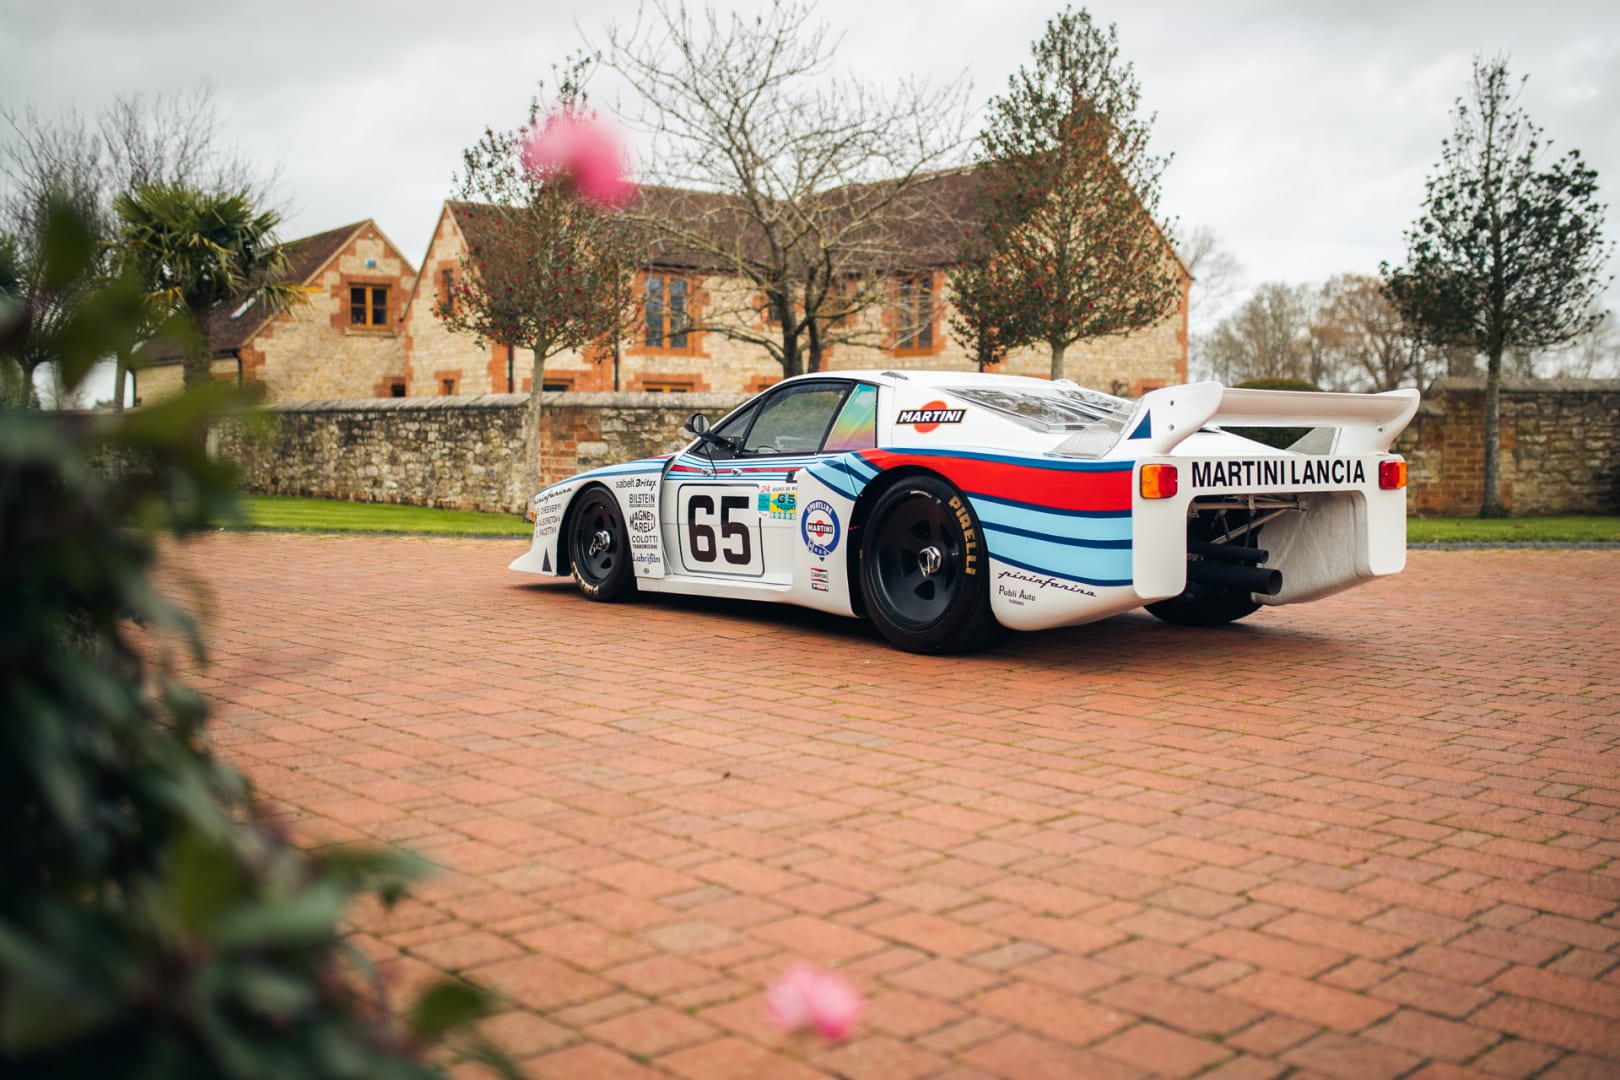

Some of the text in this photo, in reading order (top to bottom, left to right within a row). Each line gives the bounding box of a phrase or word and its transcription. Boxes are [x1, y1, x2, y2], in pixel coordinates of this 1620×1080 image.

[899, 410, 963, 423] MARTINI
[1191, 459, 1366, 488] MARTINI LANCIA
[615, 478, 657, 491] sabelt Britax
[629, 493, 655, 503] BILSTEIN
[688, 494, 752, 565] 65
[808, 524, 833, 533] MARTINI
[948, 495, 976, 575] PIRELLI
[631, 535, 658, 543] COLOTTI
[997, 570, 1097, 597] pininfarina
[998, 584, 1036, 602] Publi Auto
